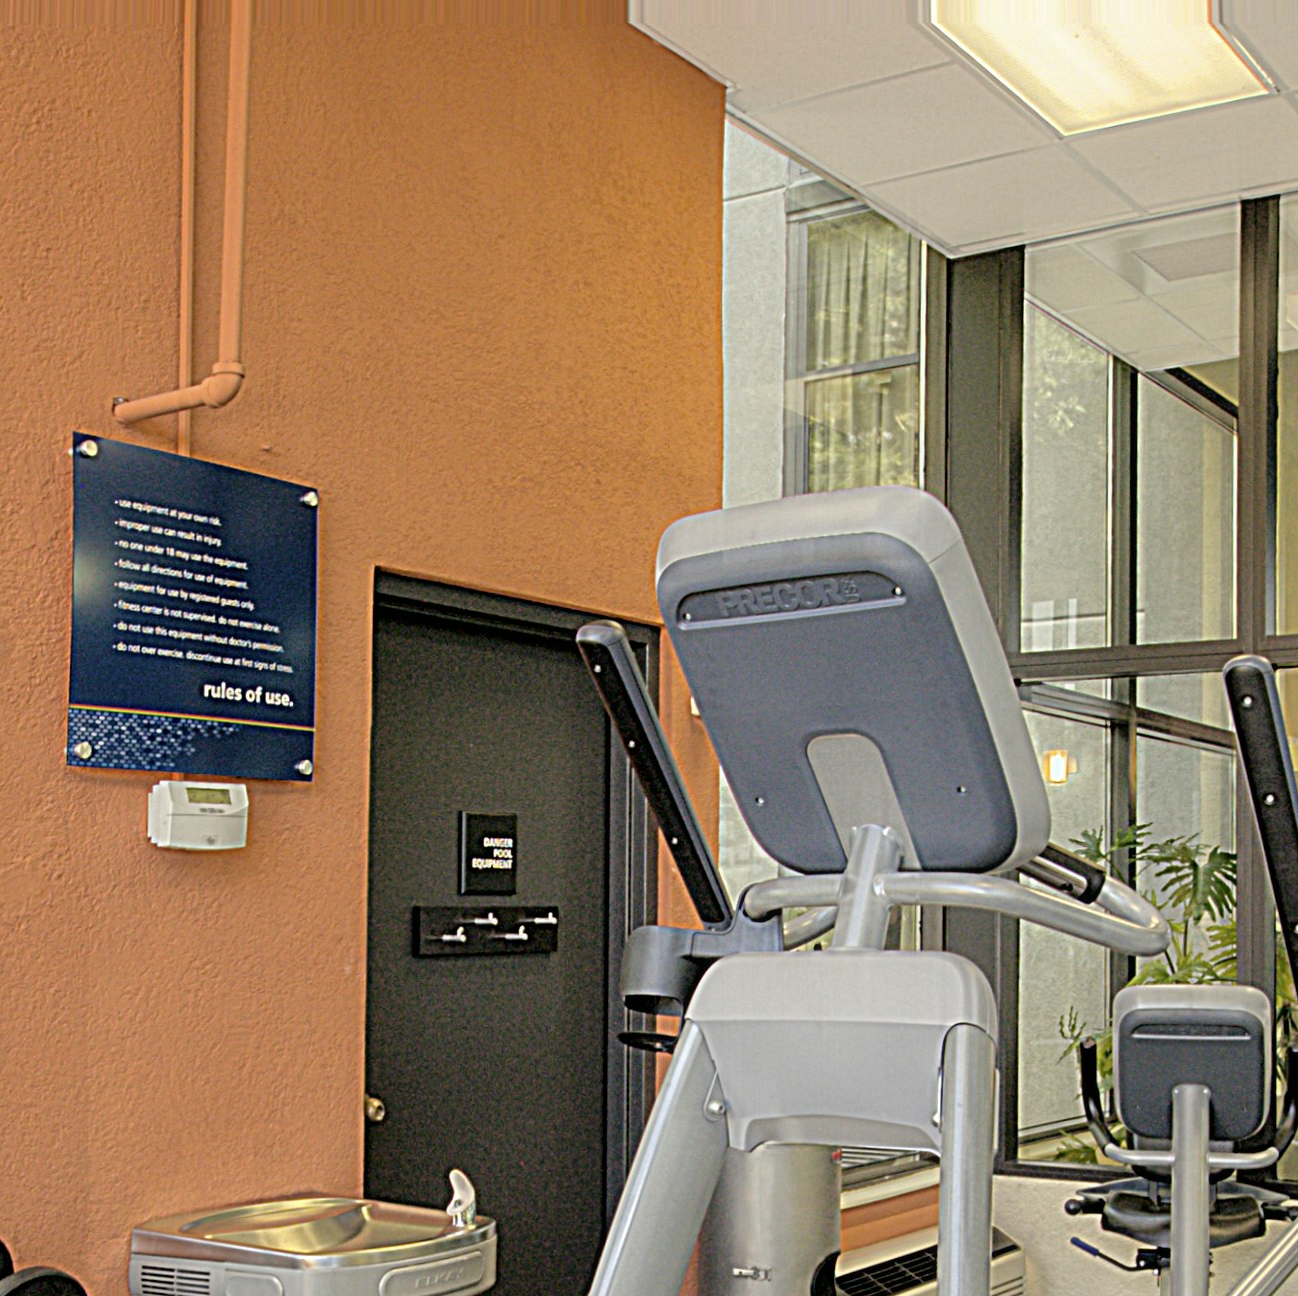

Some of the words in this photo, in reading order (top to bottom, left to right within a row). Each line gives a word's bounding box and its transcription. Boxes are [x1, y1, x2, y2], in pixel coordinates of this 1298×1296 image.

[119, 500, 132, 509] use
[132, 502, 169, 513] equipment
[178, 511, 193, 520] your
[193, 514, 208, 523] own
[119, 518, 150, 531] improper
[151, 526, 163, 534] use
[164, 528, 176, 537] can
[177, 530, 195, 540] result
[119, 540, 129, 549] no
[129, 542, 143, 551] one
[144, 544, 164, 555] under
[175, 550, 190, 561] may
[191, 553, 202, 562] use
[203, 553, 214, 563] the
[119, 559, 141, 571] follow
[151, 565, 183, 578] directions
[184, 570, 194, 579] for
[194, 574, 206, 582] use
[118, 581, 155, 593] equipment
[156, 585, 166, 595] for
[167, 589, 179, 597] use
[189, 592, 220, 604] registered
[221, 598, 241, 607] guests
[718, 577, 841, 618] PRECOR
[118, 600, 141, 611] fitness
[141, 605, 163, 615] center
[170, 609, 183, 618] not
[228, 619, 239, 627] not
[117, 621, 128, 631] do
[128, 624, 141, 633] not
[142, 626, 154, 635] use
[155, 626, 168, 636] this
[168, 629, 203, 641] equipment
[204, 634, 228, 645] without
[117, 641, 127, 651] do
[128, 645, 141, 653] not
[141, 646, 157, 655] over
[222, 657, 233, 665] use
[204, 682, 242, 701] rules
[245, 686, 263, 703] of
[265, 692, 294, 707] use.
[483, 837, 513, 848] DANGER
[493, 849, 513, 859] POOL
[472, 858, 513, 870] EQUIPMENT
